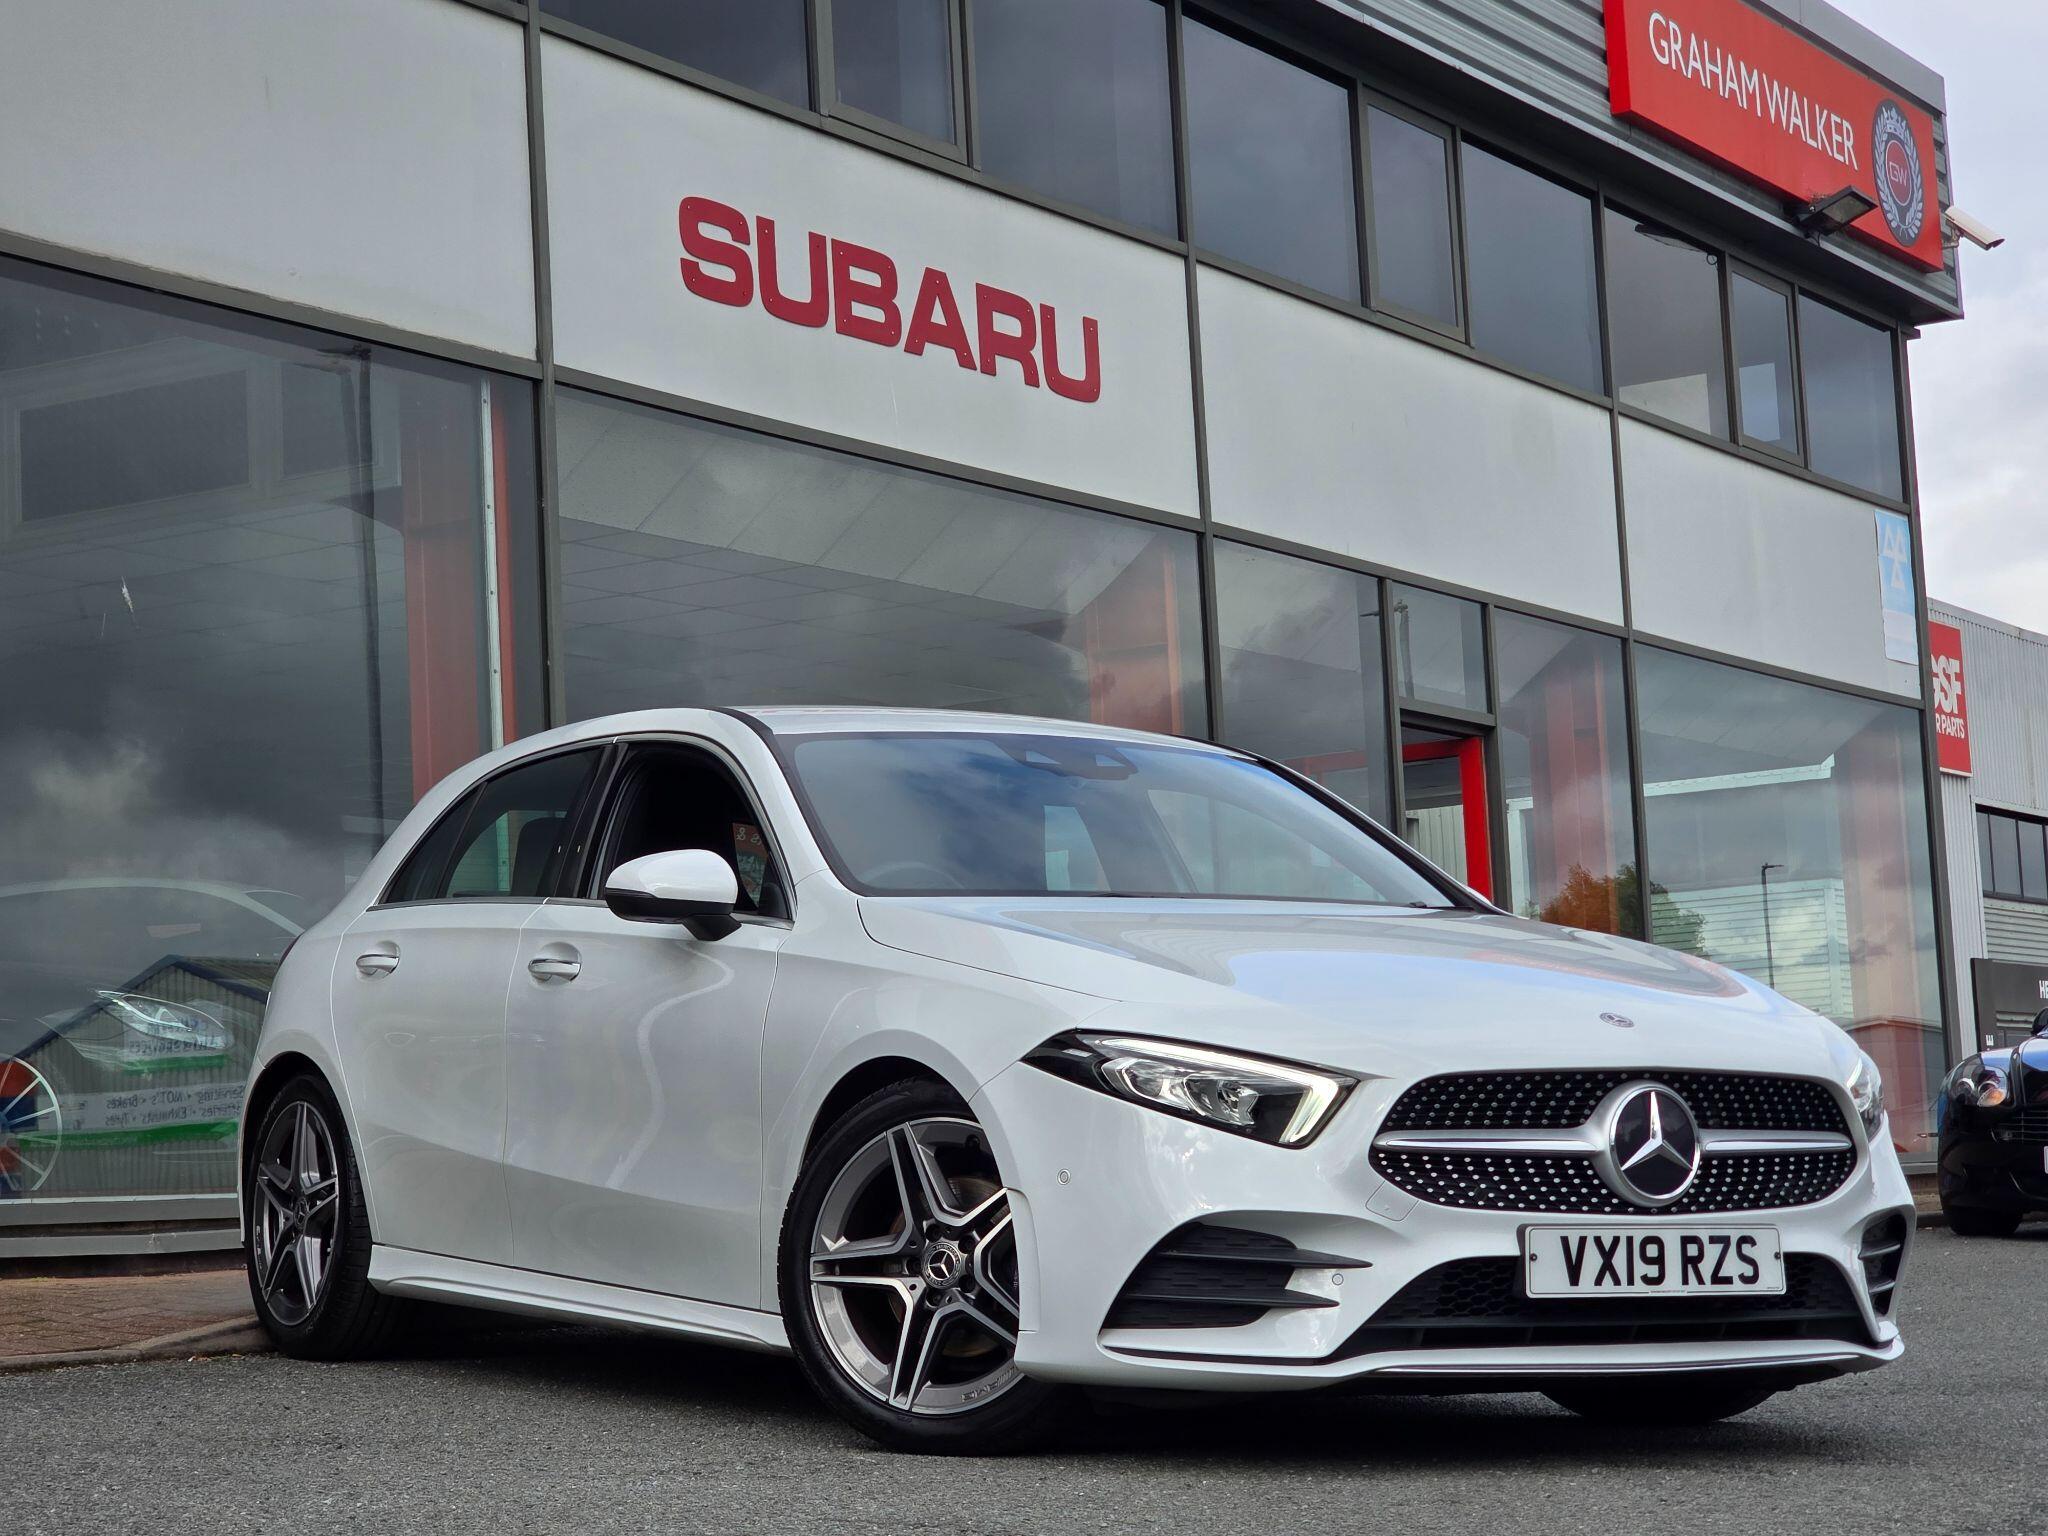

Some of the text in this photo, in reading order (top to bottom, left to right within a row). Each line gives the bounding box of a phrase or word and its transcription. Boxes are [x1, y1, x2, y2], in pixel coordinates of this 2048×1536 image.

[679, 196, 1100, 403] SUBARU
[1941, 714, 1965, 738] PARTS
[1560, 1235, 1760, 1287] VX19 RZS
